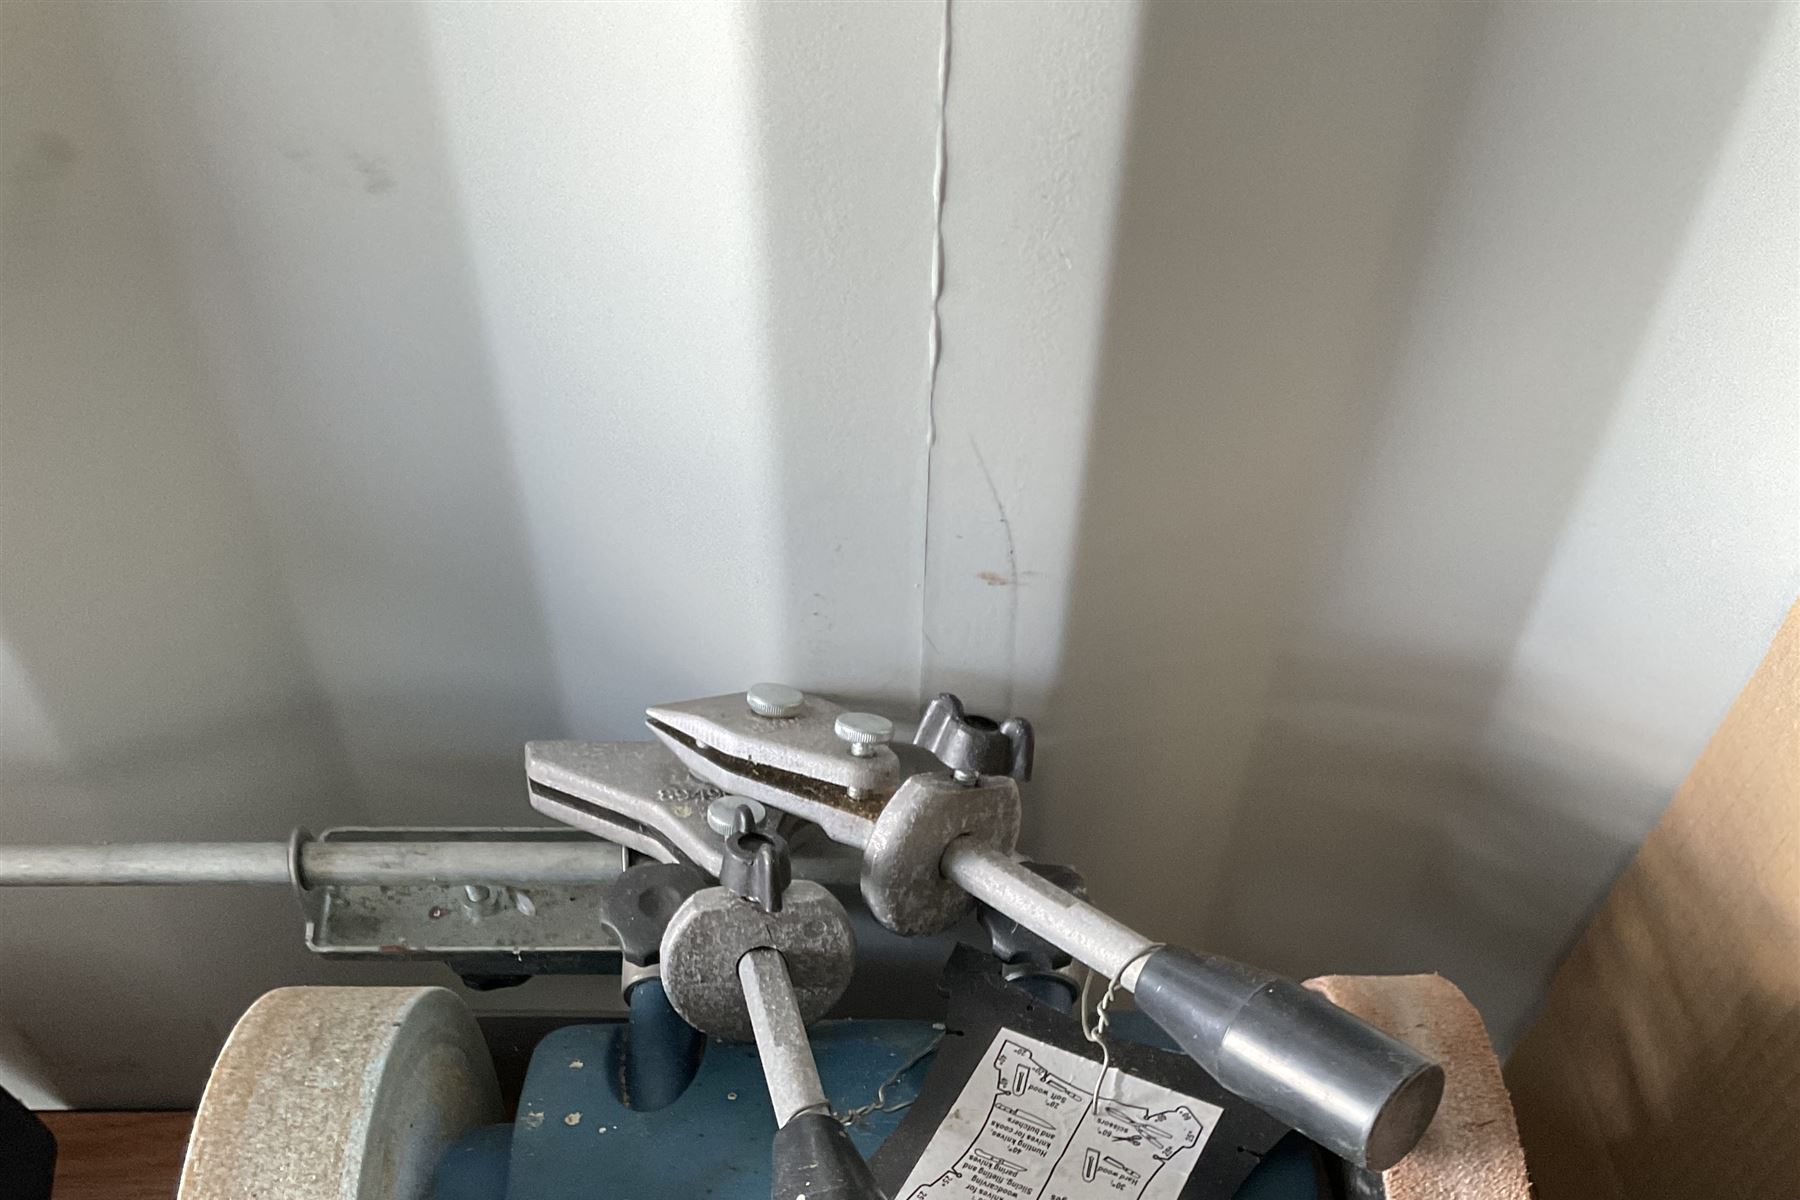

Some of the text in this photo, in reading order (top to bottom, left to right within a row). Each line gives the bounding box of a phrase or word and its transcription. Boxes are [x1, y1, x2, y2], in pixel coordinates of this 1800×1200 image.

[1028, 1084, 1048, 1096] wood
[991, 1120, 1051, 1149] knives for cooks
[1008, 1117, 1055, 1139] and butchers
[1097, 1118, 1128, 1133] scissors
[1017, 1140, 1047, 1157] Hunting
[962, 1162, 977, 1172] and
[969, 1155, 1019, 1177] paring knives
[1097, 1166, 1138, 1186] Hard wood
[965, 1184, 977, 1194] for
[971, 1175, 1018, 1198] woodcarving
